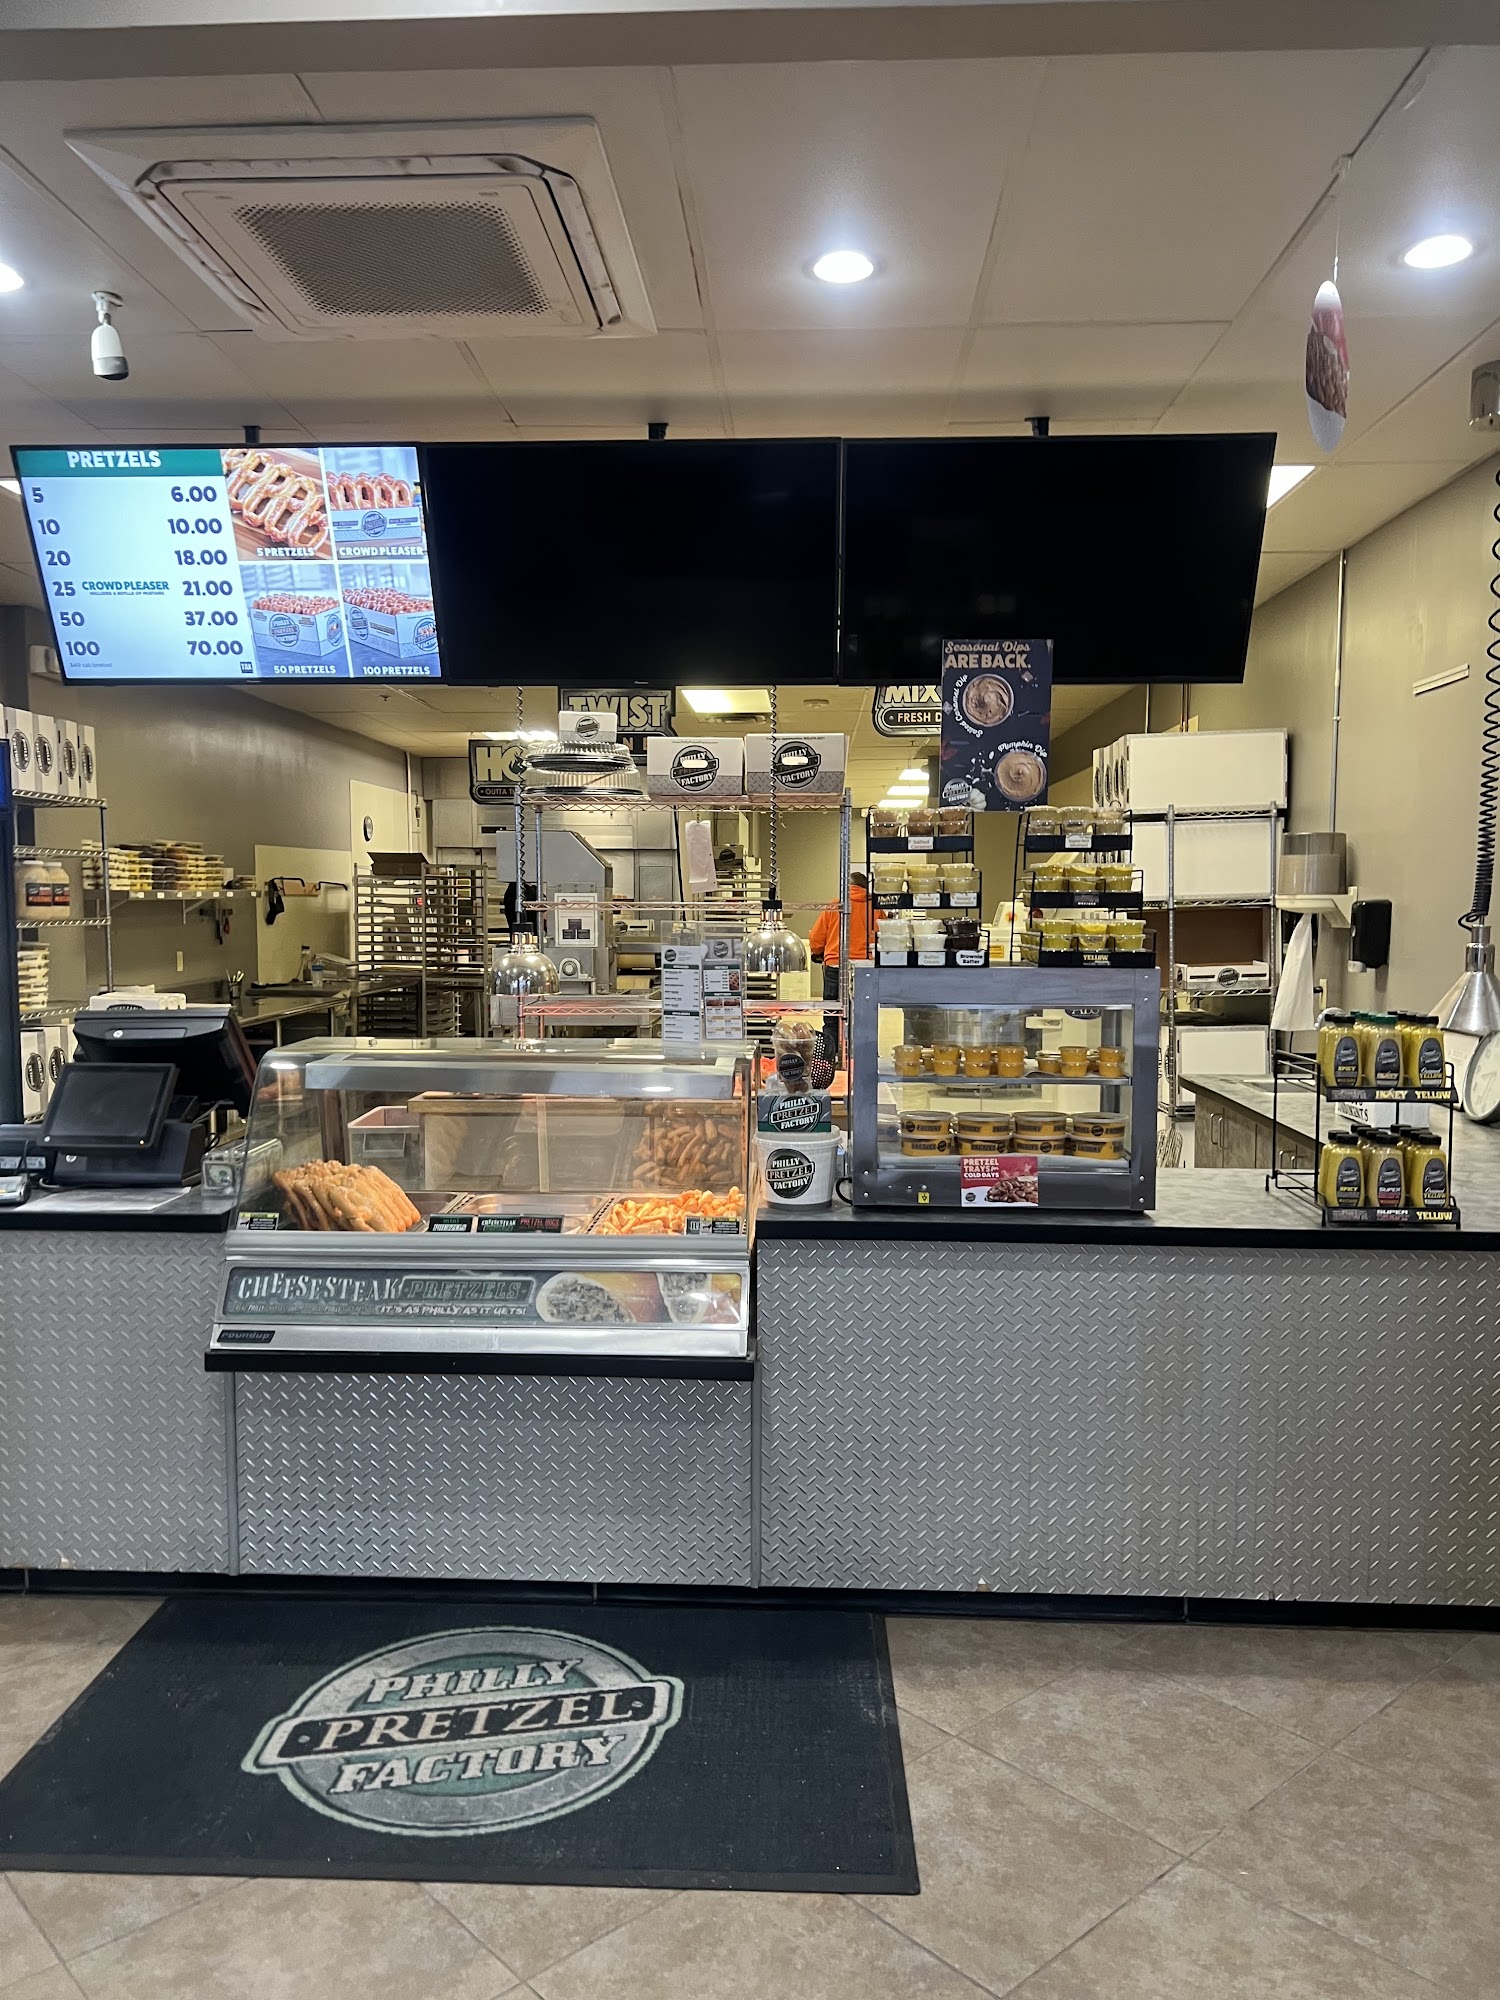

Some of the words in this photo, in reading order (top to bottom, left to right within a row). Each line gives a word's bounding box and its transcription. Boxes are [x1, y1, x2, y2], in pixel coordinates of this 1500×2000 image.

[66, 450, 162, 468] PRETZELS
[31, 487, 44, 503] 5
[171, 485, 217, 503] 6.00
[37, 518, 60, 535] 10
[167, 518, 223, 534] 10.00
[46, 550, 71, 567] 20
[175, 549, 228, 566] 18.00
[256, 547, 264, 557] 5
[265, 547, 315, 557] PRETZELS
[339, 547, 378, 556] CROWD
[379, 546, 425, 556] PLEASER
[52, 580, 76, 597] 25
[81, 581, 123, 591] CROWD
[124, 581, 170, 591] PLEASER
[182, 580, 233, 596] 21.00
[59, 611, 85, 627] 50
[184, 610, 239, 626] 37.00
[65, 640, 100, 656] 100
[186, 640, 243, 656] 70.00
[945, 640, 999, 654] Seasonal
[1002, 640, 1031, 655] Dips
[944, 654, 980, 669] ARE
[981, 654, 1032, 669] BACK.
[273, 665, 287, 674] 50
[288, 665, 336, 674] PRETZELS
[362, 666, 382, 675] 100
[383, 666, 431, 675] PRETZELS
[955, 674, 969, 688] Dip
[568, 695, 666, 728] TWIST
[897, 712, 931, 723] FRESH
[959, 720, 984, 738] Salted
[997, 739, 1034, 753] Pumpkin
[681, 772, 714, 787] FACTORY
[782, 769, 816, 784] FACTORY
[1375, 1088, 1408, 1100] HONEY
[1414, 1090, 1452, 1099] YELLOW
[779, 1097, 808, 1110] PHILLY
[776, 1106, 816, 1121] PRETZEL
[780, 1115, 815, 1130] FACTORY
[772, 1157, 800, 1168] PHILLY
[963, 1158, 1000, 1166] PRETZEL
[769, 1165, 810, 1179] PRETZEL
[773, 1177, 810, 1190] FACTORY
[1416, 1211, 1453, 1220] YELLOW
[238, 1271, 400, 1302] CHEESESTEAK
[407, 1279, 523, 1300] PRETZELS
[380, 1304, 402, 1313] IT'S
[404, 1304, 420, 1314] AS
[421, 1304, 460, 1315] PHILLY
[462, 1305, 478, 1315] AS
[480, 1306, 492, 1315] IT
[493, 1306, 526, 1317] GETS!
[221, 1331, 271, 1341] roundup
[365, 1657, 584, 1704] PHILLY
[313, 1690, 636, 1752] PRETZEL
[327, 1732, 627, 1795] FACTORY
